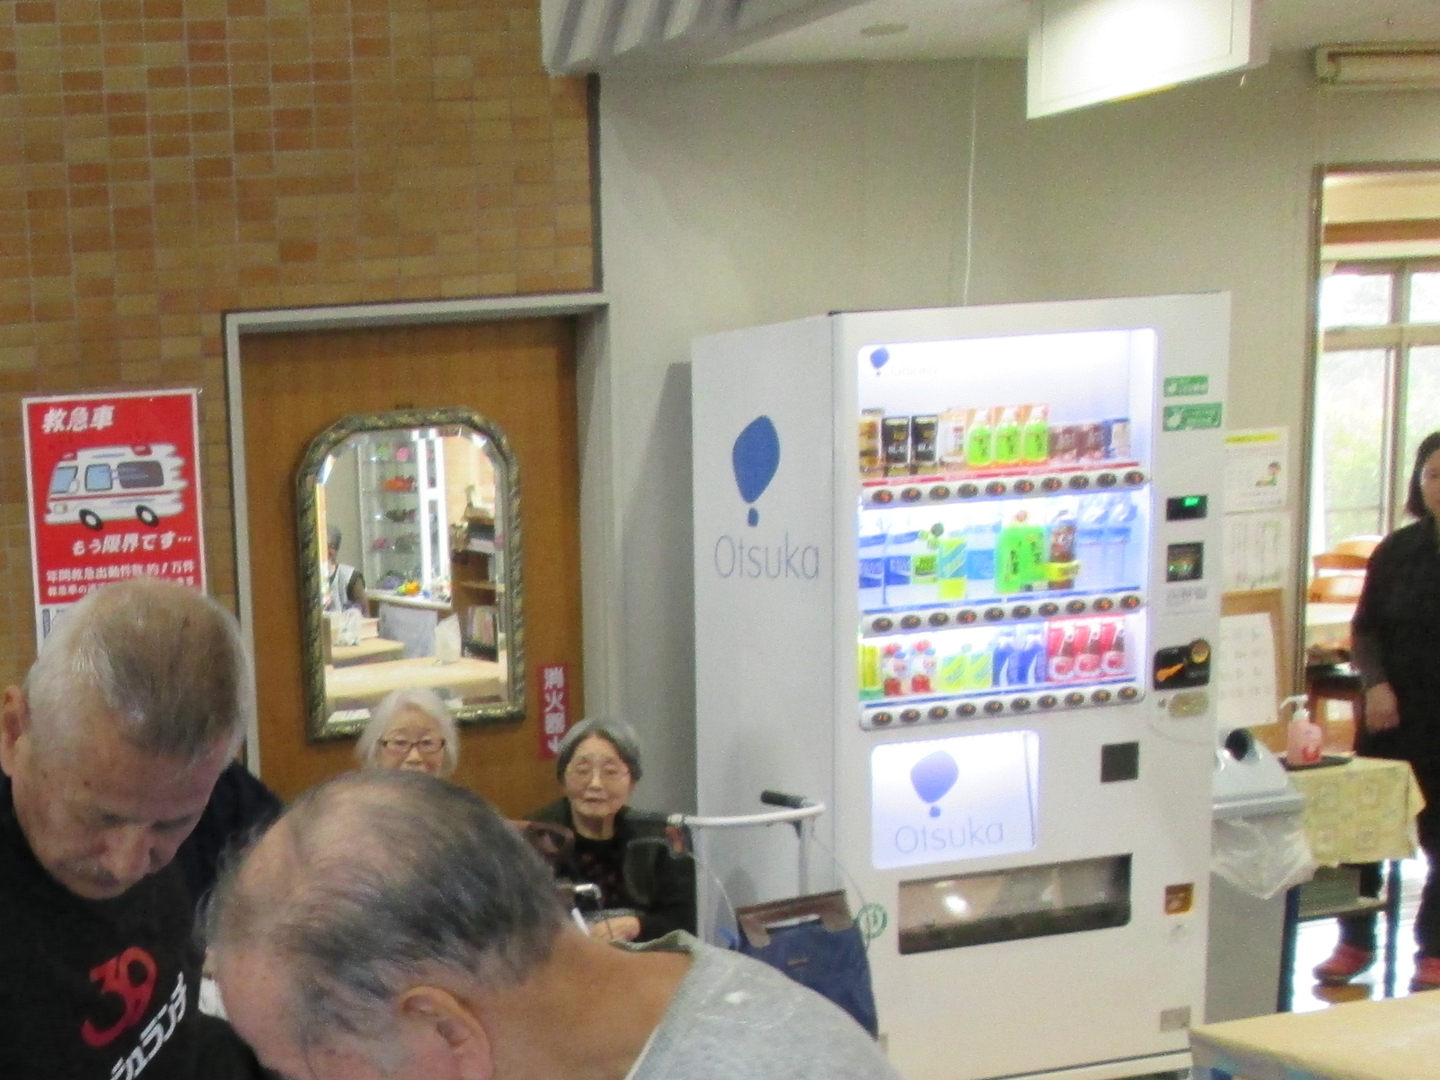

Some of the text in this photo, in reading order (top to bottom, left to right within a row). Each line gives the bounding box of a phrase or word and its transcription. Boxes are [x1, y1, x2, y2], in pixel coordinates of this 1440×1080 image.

[41, 405, 116, 435] 救急車
[714, 530, 820, 580] Otsuka
[543, 666, 566, 734] 消火器
[894, 817, 1005, 854] Otsuka
